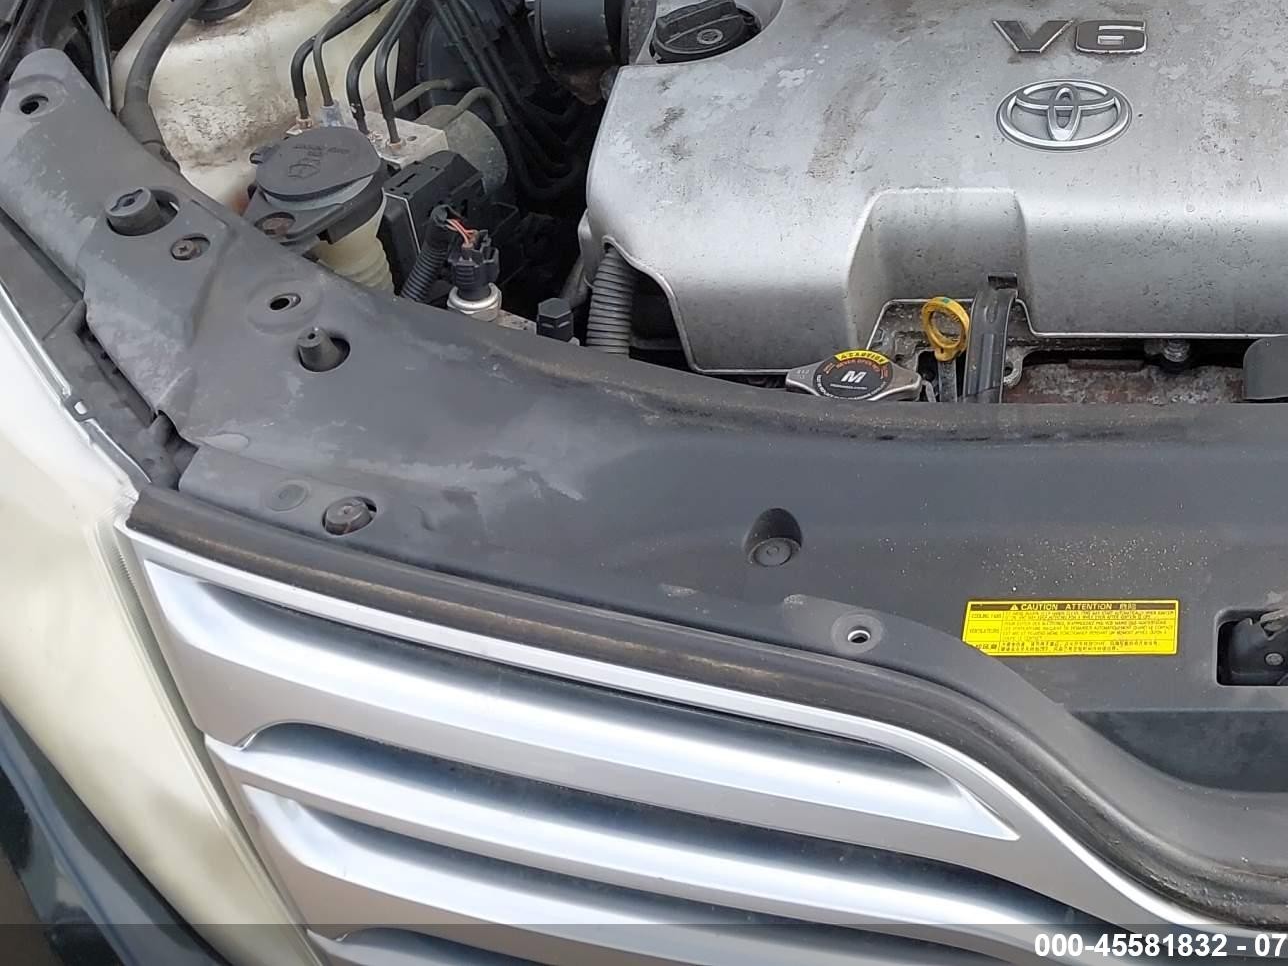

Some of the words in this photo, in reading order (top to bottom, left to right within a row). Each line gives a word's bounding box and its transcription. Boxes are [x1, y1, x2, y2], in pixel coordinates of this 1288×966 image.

[992, 19, 1147, 54] V6
[848, 352, 885, 363] CAUTION
[841, 370, 867, 382] M
[1020, 603, 1058, 611] CAUTION
[1064, 603, 1113, 611] ATTENTION
